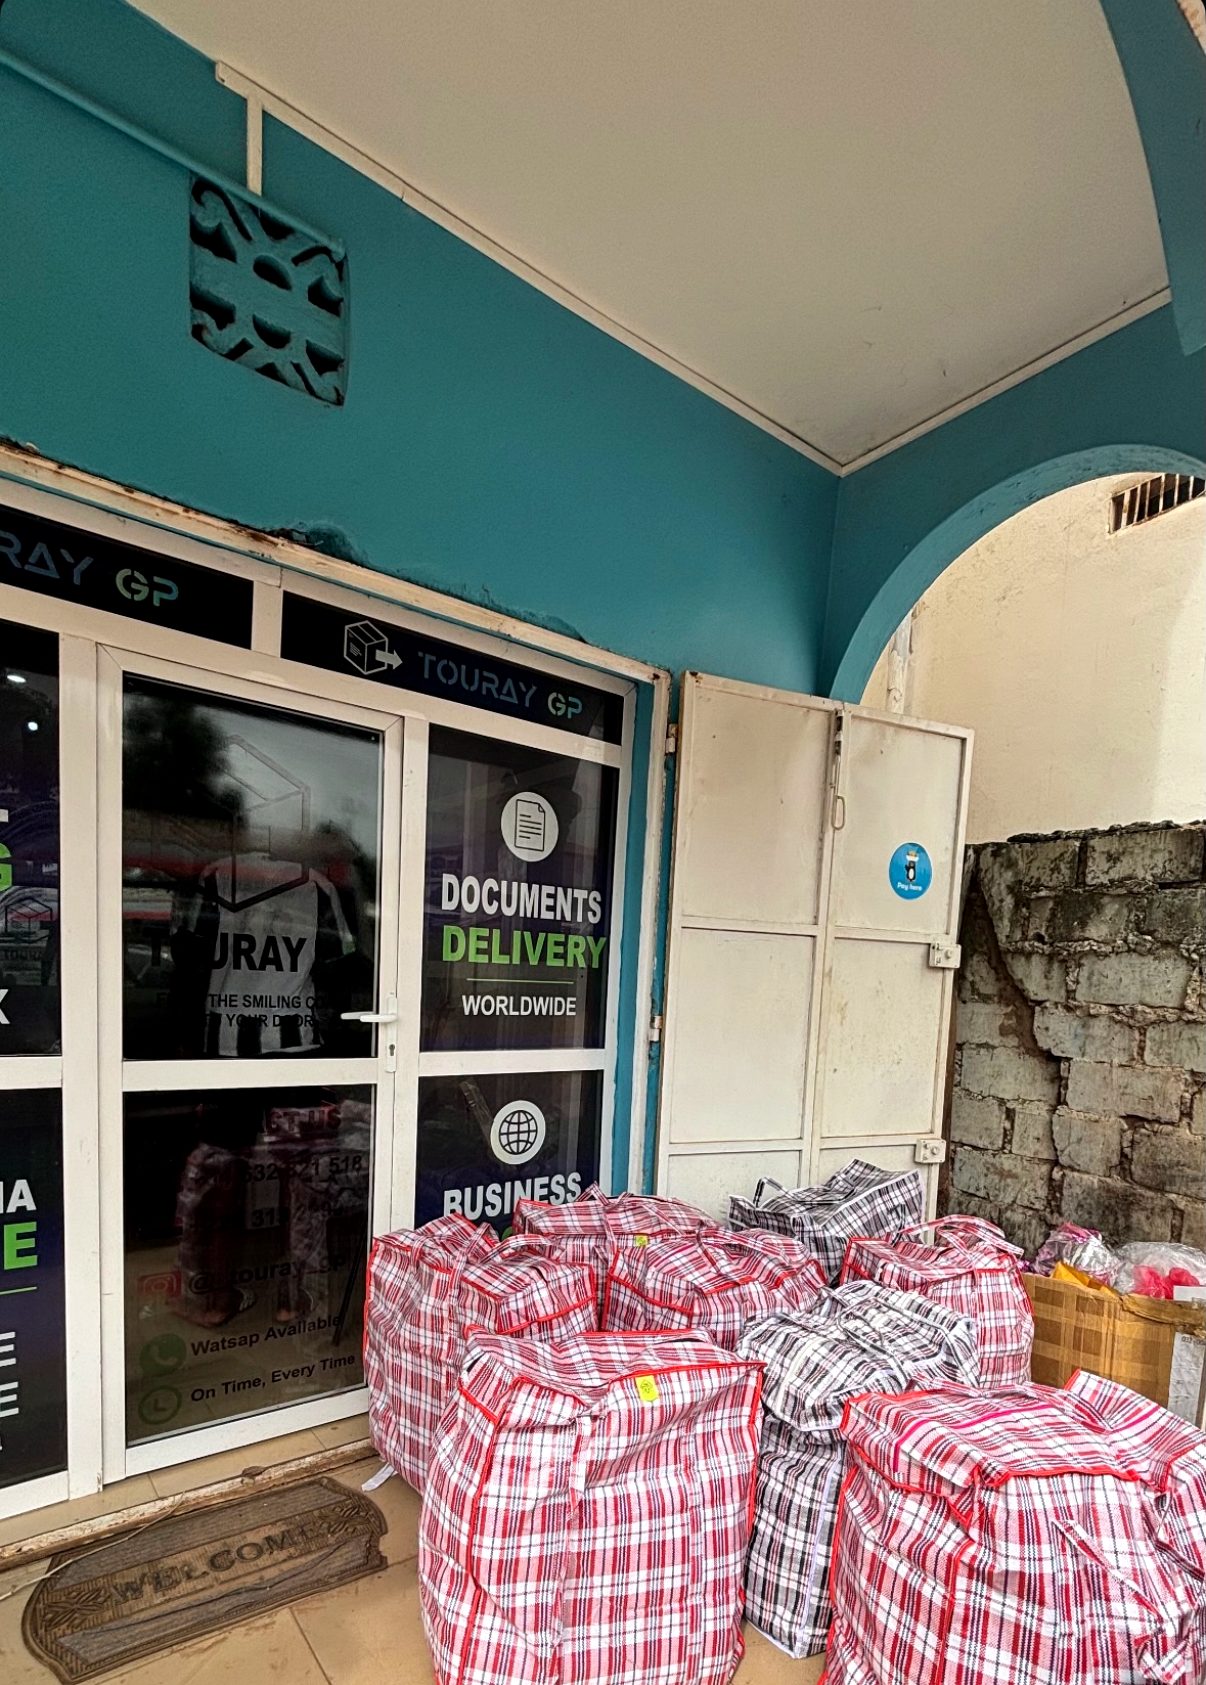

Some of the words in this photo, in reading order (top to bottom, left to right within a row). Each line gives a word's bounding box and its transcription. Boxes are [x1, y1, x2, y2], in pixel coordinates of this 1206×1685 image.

[115, 568, 179, 607] GP
[418, 651, 537, 708] TOURAY
[547, 692, 583, 719] GP
[441, 873, 602, 924] DOCUMENTS
[442, 925, 607, 969] DELIVERY
[209, 994, 238, 1008] THE
[242, 994, 302, 1009] SMILING
[462, 995, 577, 1016] WORLDWIDE
[443, 1171, 582, 1221] BUSINESS
[191, 1330, 260, 1356] Watsap
[264, 1315, 341, 1341] Available
[191, 1386, 215, 1402] On
[221, 1376, 266, 1395] Time,
[271, 1364, 315, 1383] Every
[320, 1354, 355, 1371] Time
